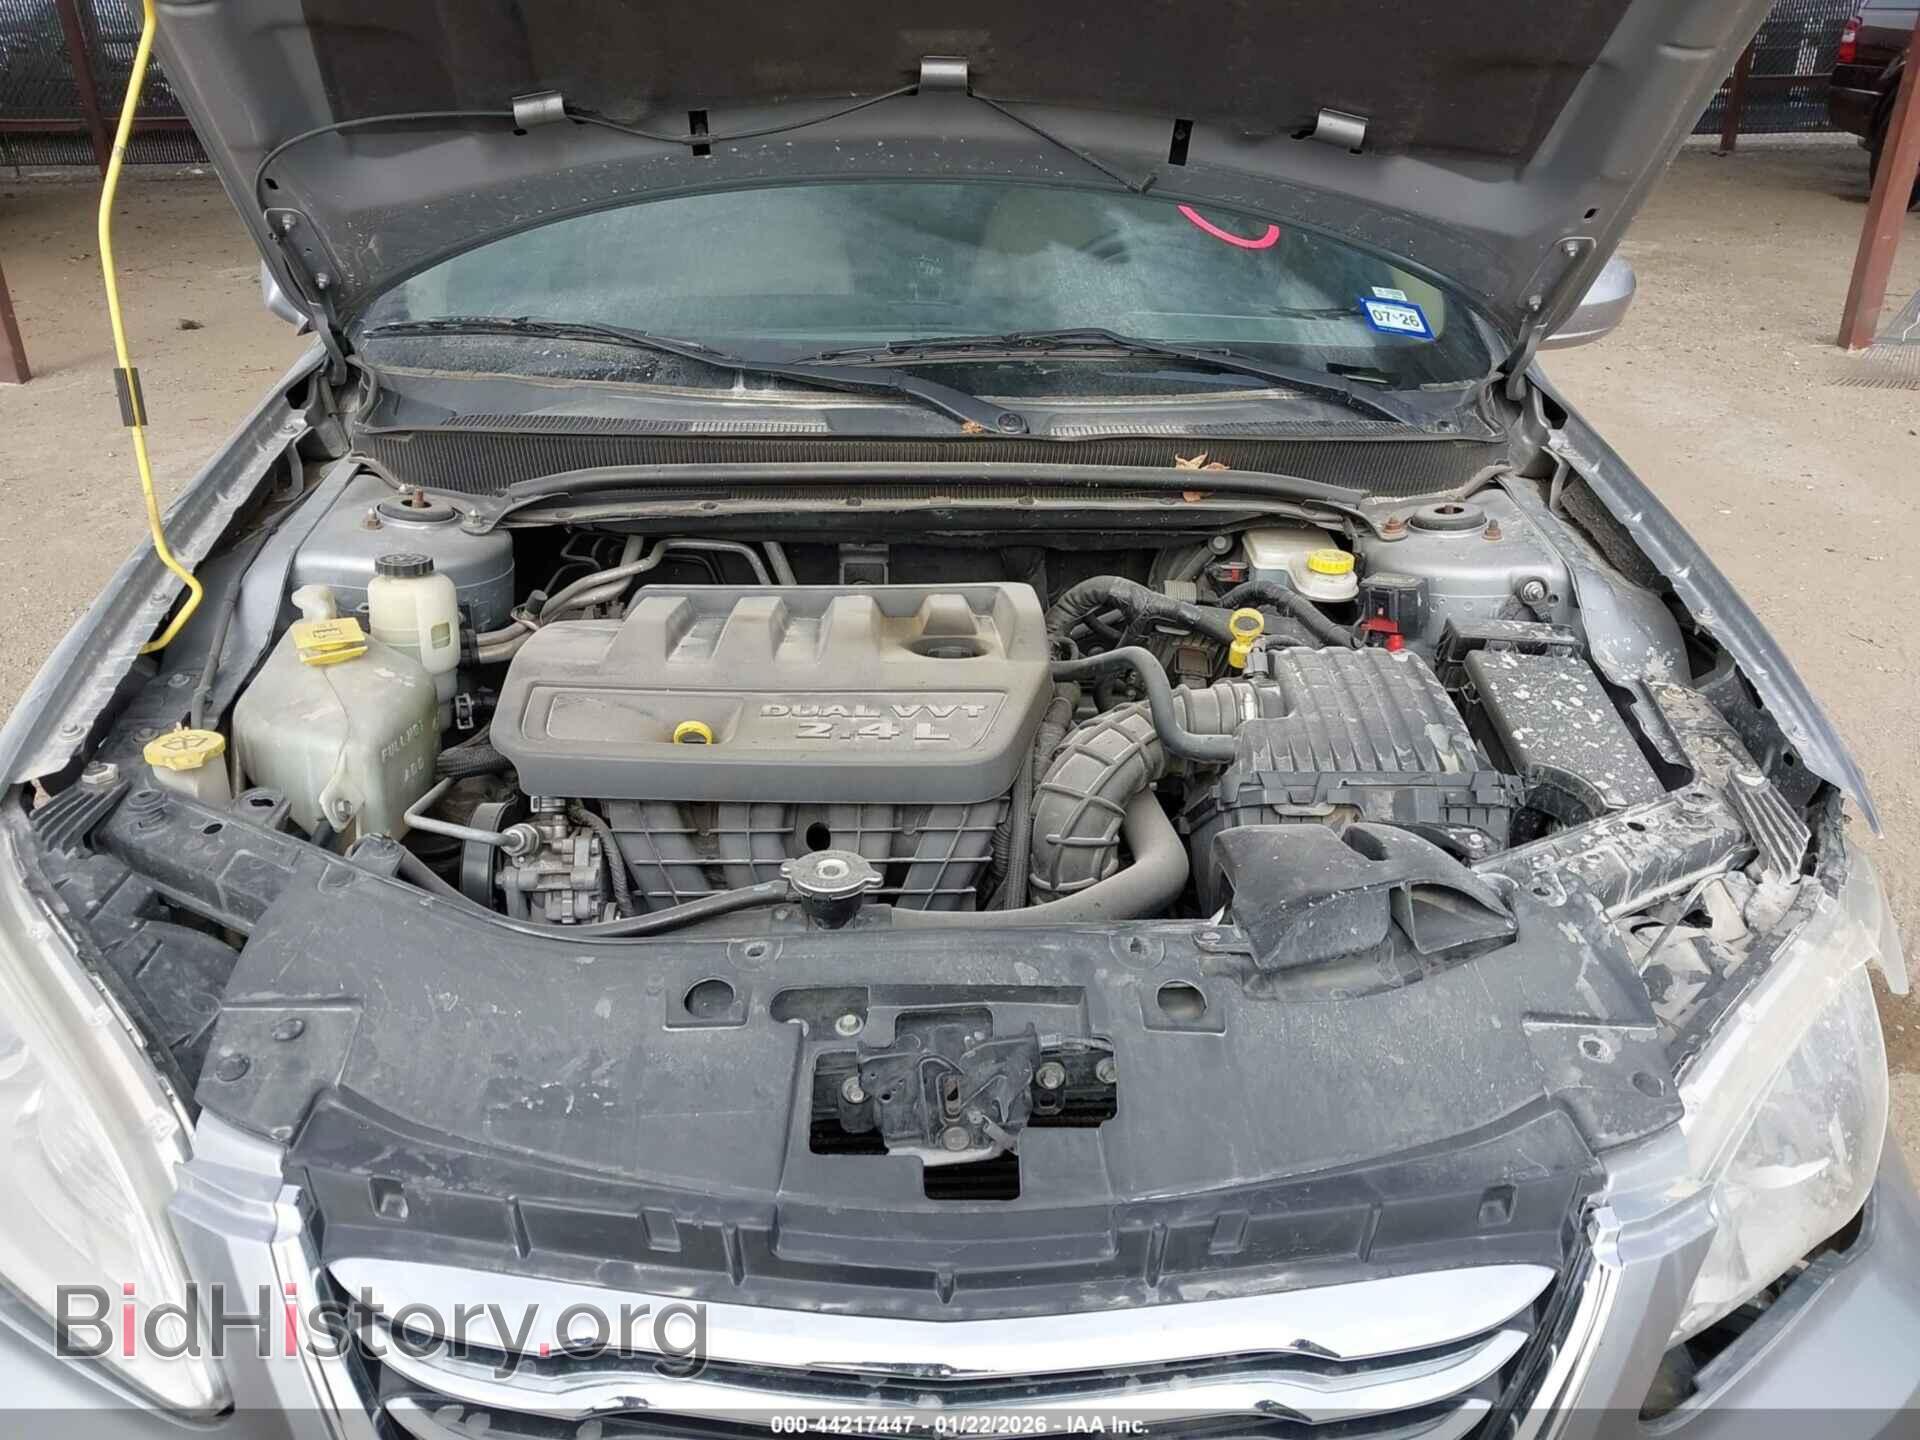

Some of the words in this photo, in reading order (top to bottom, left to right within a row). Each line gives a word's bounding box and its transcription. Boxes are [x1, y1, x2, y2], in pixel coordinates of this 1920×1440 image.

[1373, 309, 1391, 322] 07
[1400, 313, 1420, 327] 26
[759, 704, 881, 718] DUAL
[889, 704, 987, 718] VVT
